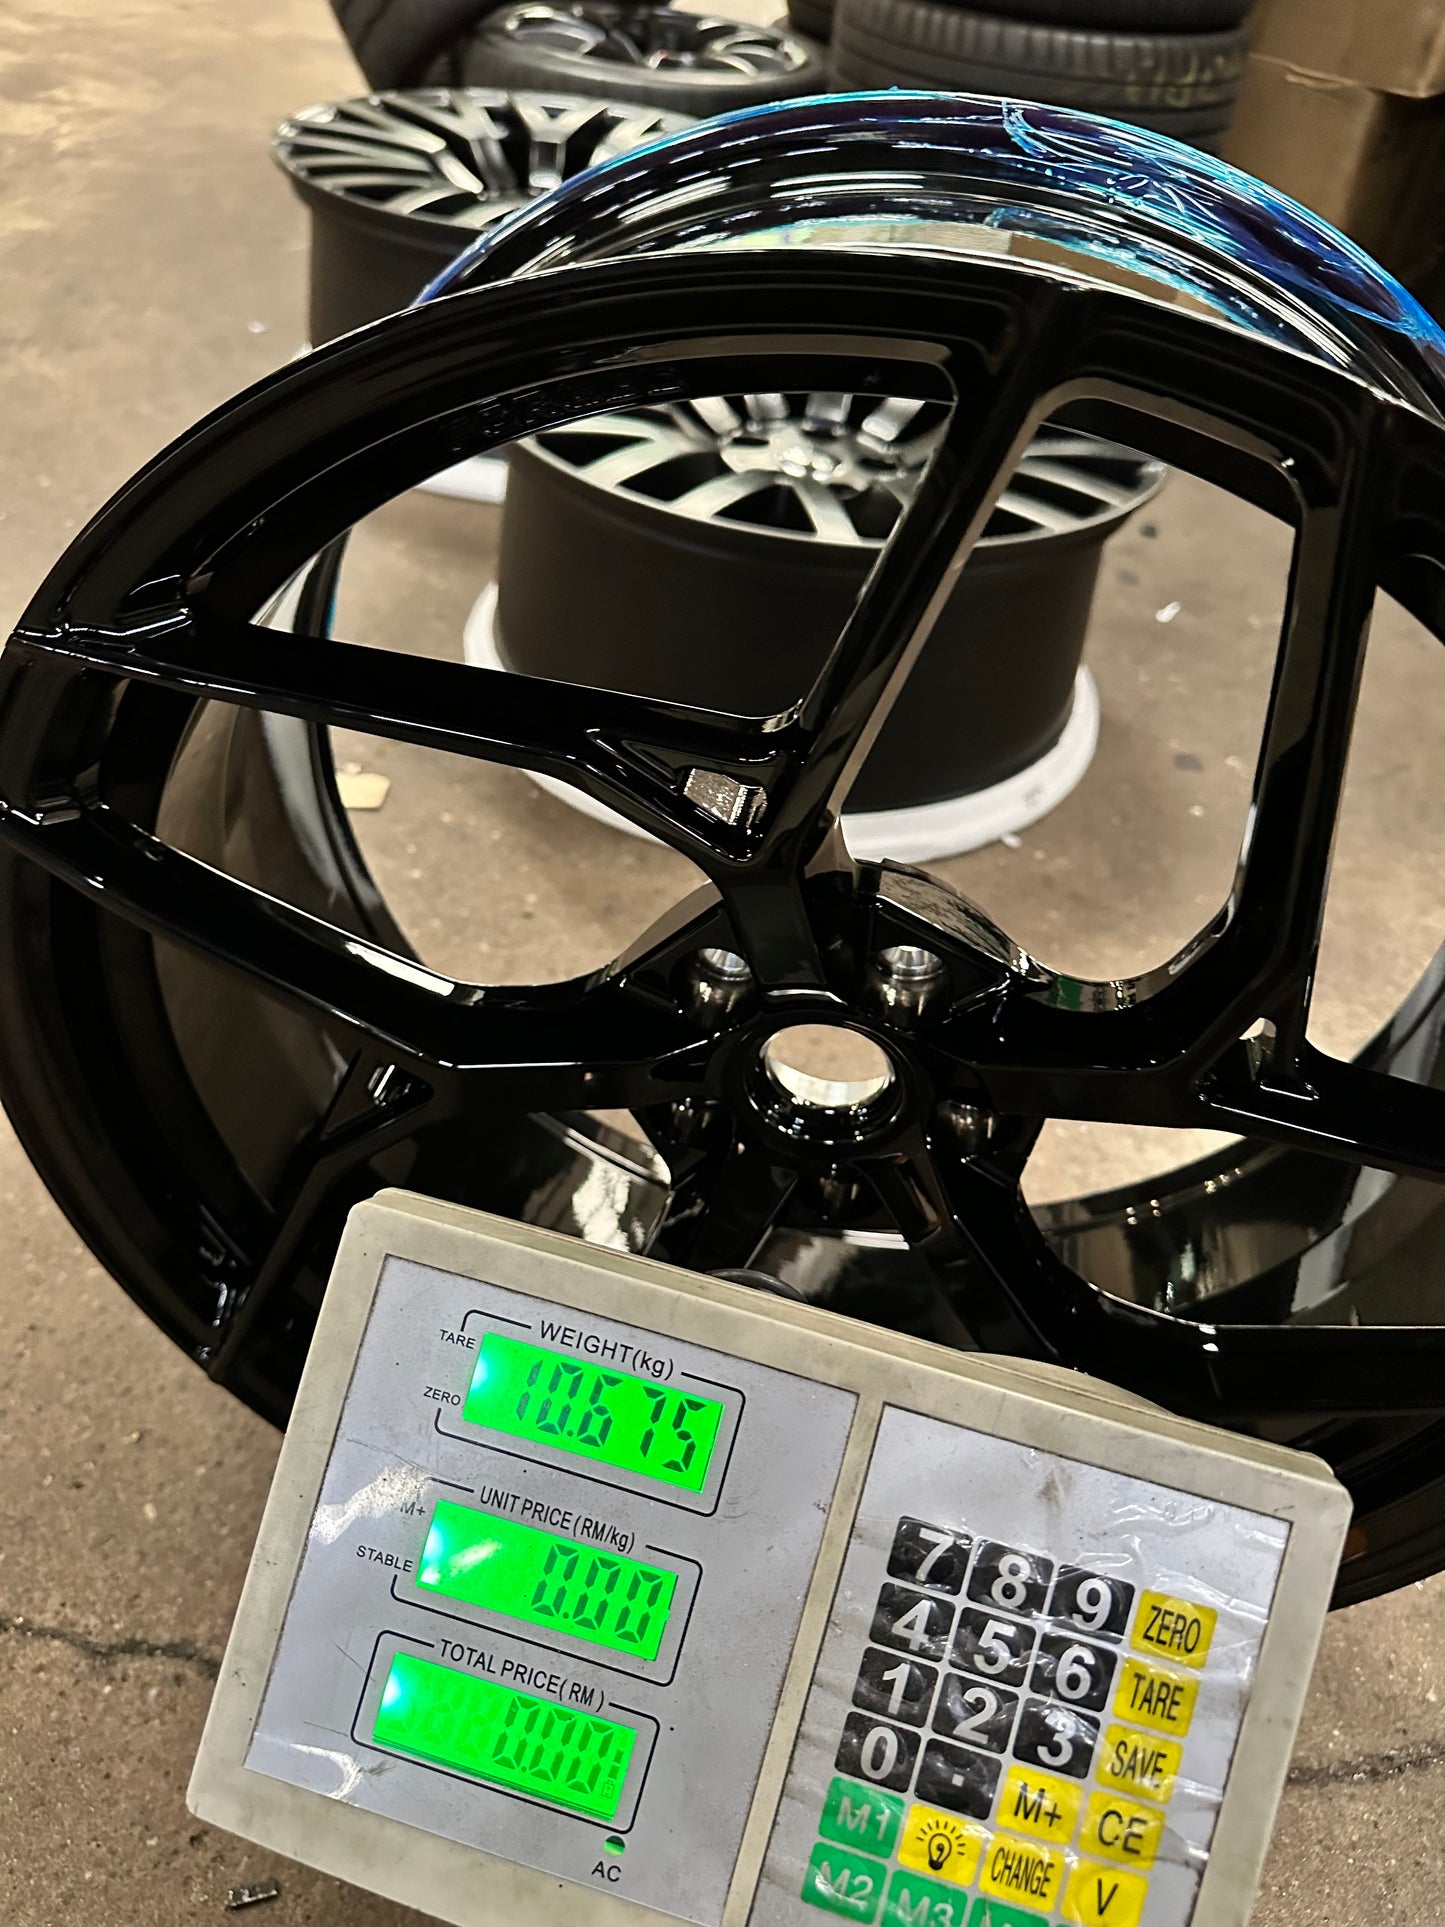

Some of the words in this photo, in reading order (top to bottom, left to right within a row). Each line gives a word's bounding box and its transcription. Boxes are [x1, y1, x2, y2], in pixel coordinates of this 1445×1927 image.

[439, 1329, 476, 1350] TARE
[539, 1320, 675, 1381] WEIGHT(kg)
[423, 1386, 461, 1406] ZERO
[400, 1501, 426, 1515] M+
[479, 1486, 521, 1514] UNIT
[356, 1545, 413, 1573] STABLE
[917, 1527, 956, 1582] 7
[531, 1544, 664, 1643] 0.00
[991, 1554, 1032, 1608] 8
[1072, 1578, 1113, 1632] 9
[892, 1599, 932, 1652] 4
[974, 1619, 1017, 1675] 5
[1142, 1605, 1201, 1655] ZERO
[439, 1639, 497, 1674] TOTAL
[1055, 1646, 1093, 1700] 6
[881, 1663, 912, 1716] 1
[1132, 1672, 1184, 1722] TARE
[952, 1687, 998, 1744] 2
[1037, 1711, 1076, 1767] 3
[492, 1695, 615, 1795] 0.00
[859, 1726, 899, 1781] 0
[1110, 1740, 1168, 1789] SAVE
[836, 1795, 893, 1842] M1
[1012, 1781, 1063, 1830] M+
[1098, 1810, 1148, 1855] CE
[591, 1860, 622, 1883] AC
[815, 1861, 874, 1909] M2
[991, 1847, 1055, 1898] CHANGE
[1097, 1878, 1119, 1916] V
